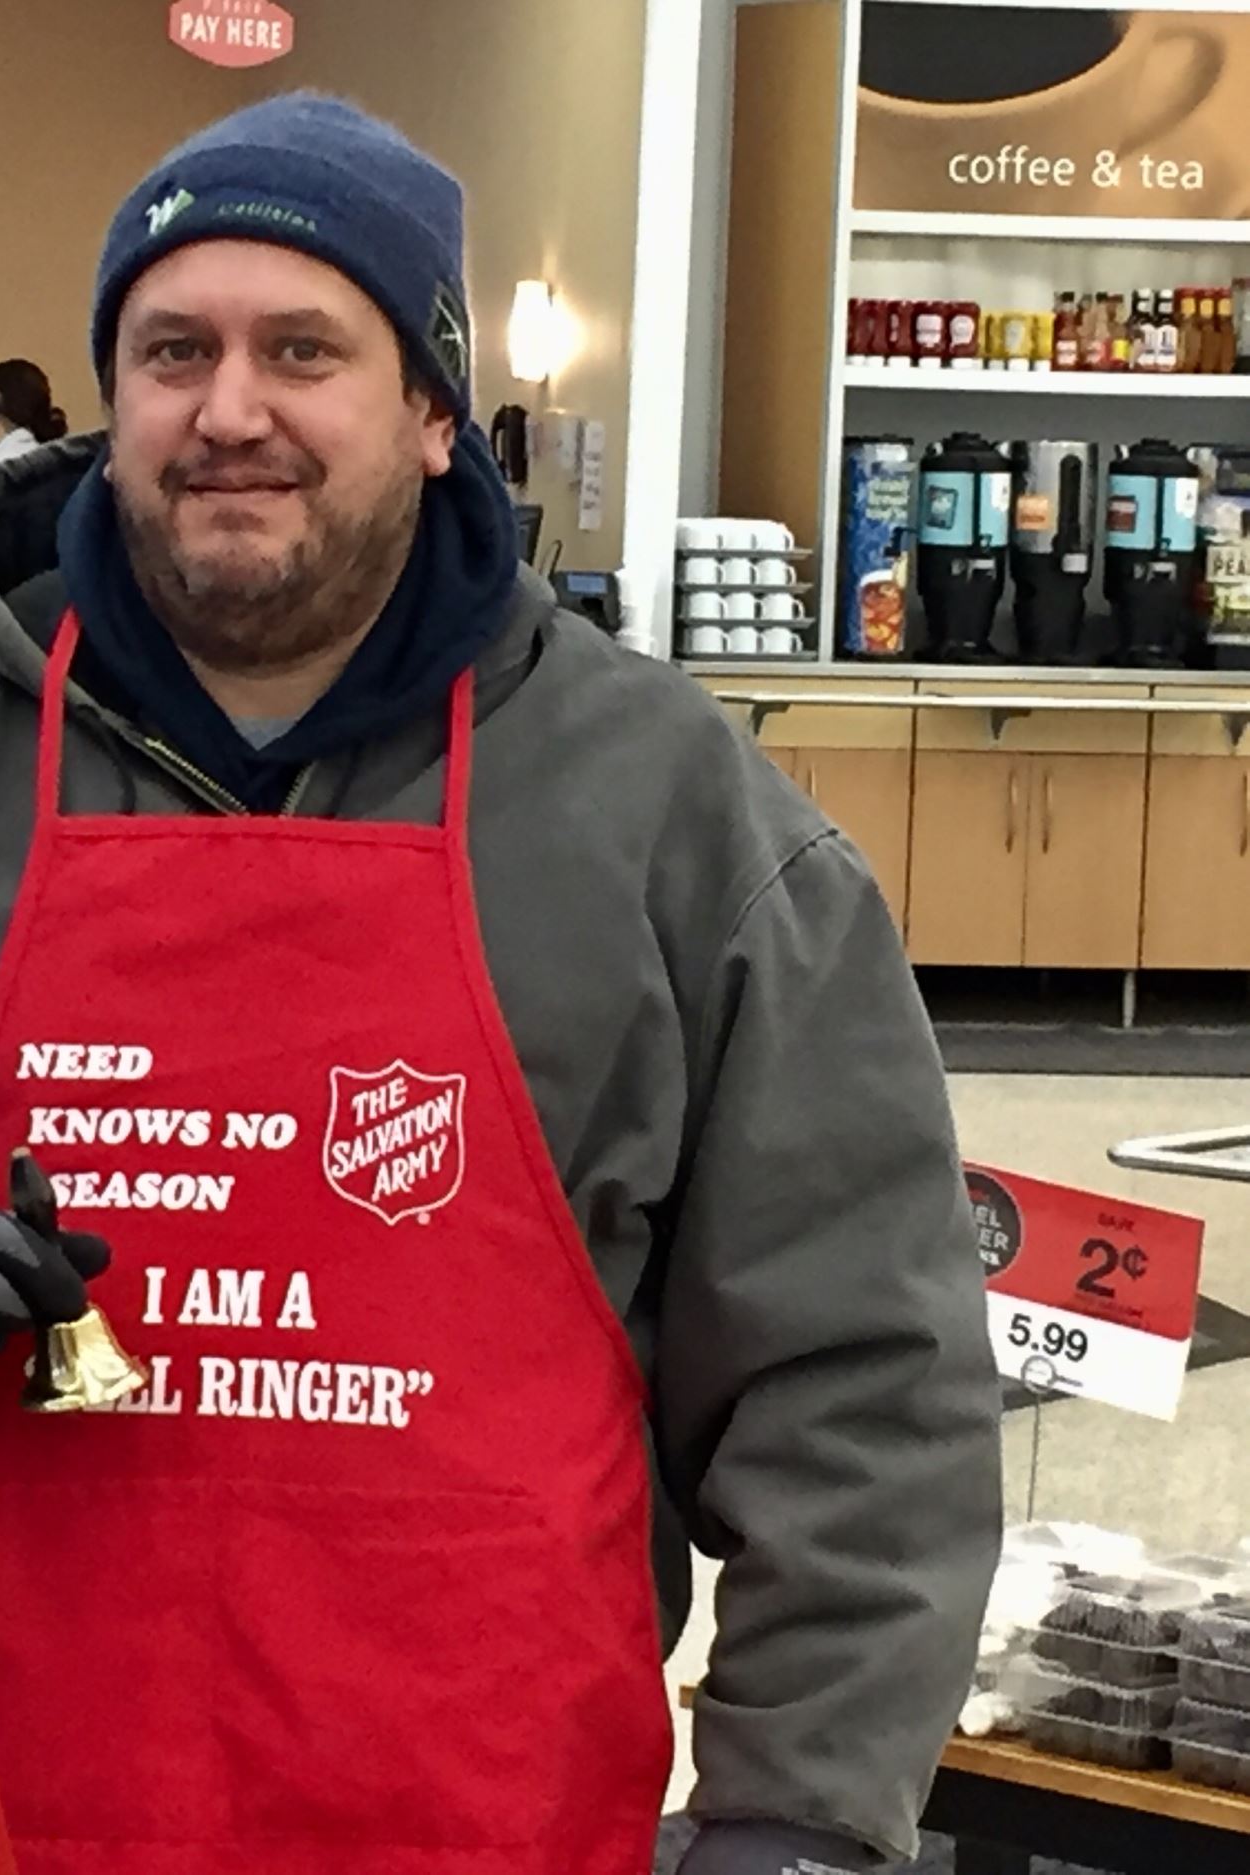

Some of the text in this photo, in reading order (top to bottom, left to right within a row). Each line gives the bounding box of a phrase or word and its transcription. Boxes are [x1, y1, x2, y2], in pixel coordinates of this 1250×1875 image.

[180, 12, 283, 49] PAY HERE
[949, 145, 1203, 190] coffee & tea
[16, 1043, 153, 1080] NEED
[352, 1077, 408, 1126] THE
[27, 1107, 297, 1150] KNOWS NO
[331, 1088, 453, 1179] SALVATION
[49, 1171, 235, 1211] SEASON
[372, 1133, 448, 1202] ARMY
[1076, 1238, 1148, 1298] 2¢
[142, 1266, 317, 1330] I AM A
[1008, 1313, 1088, 1362] 5.99
